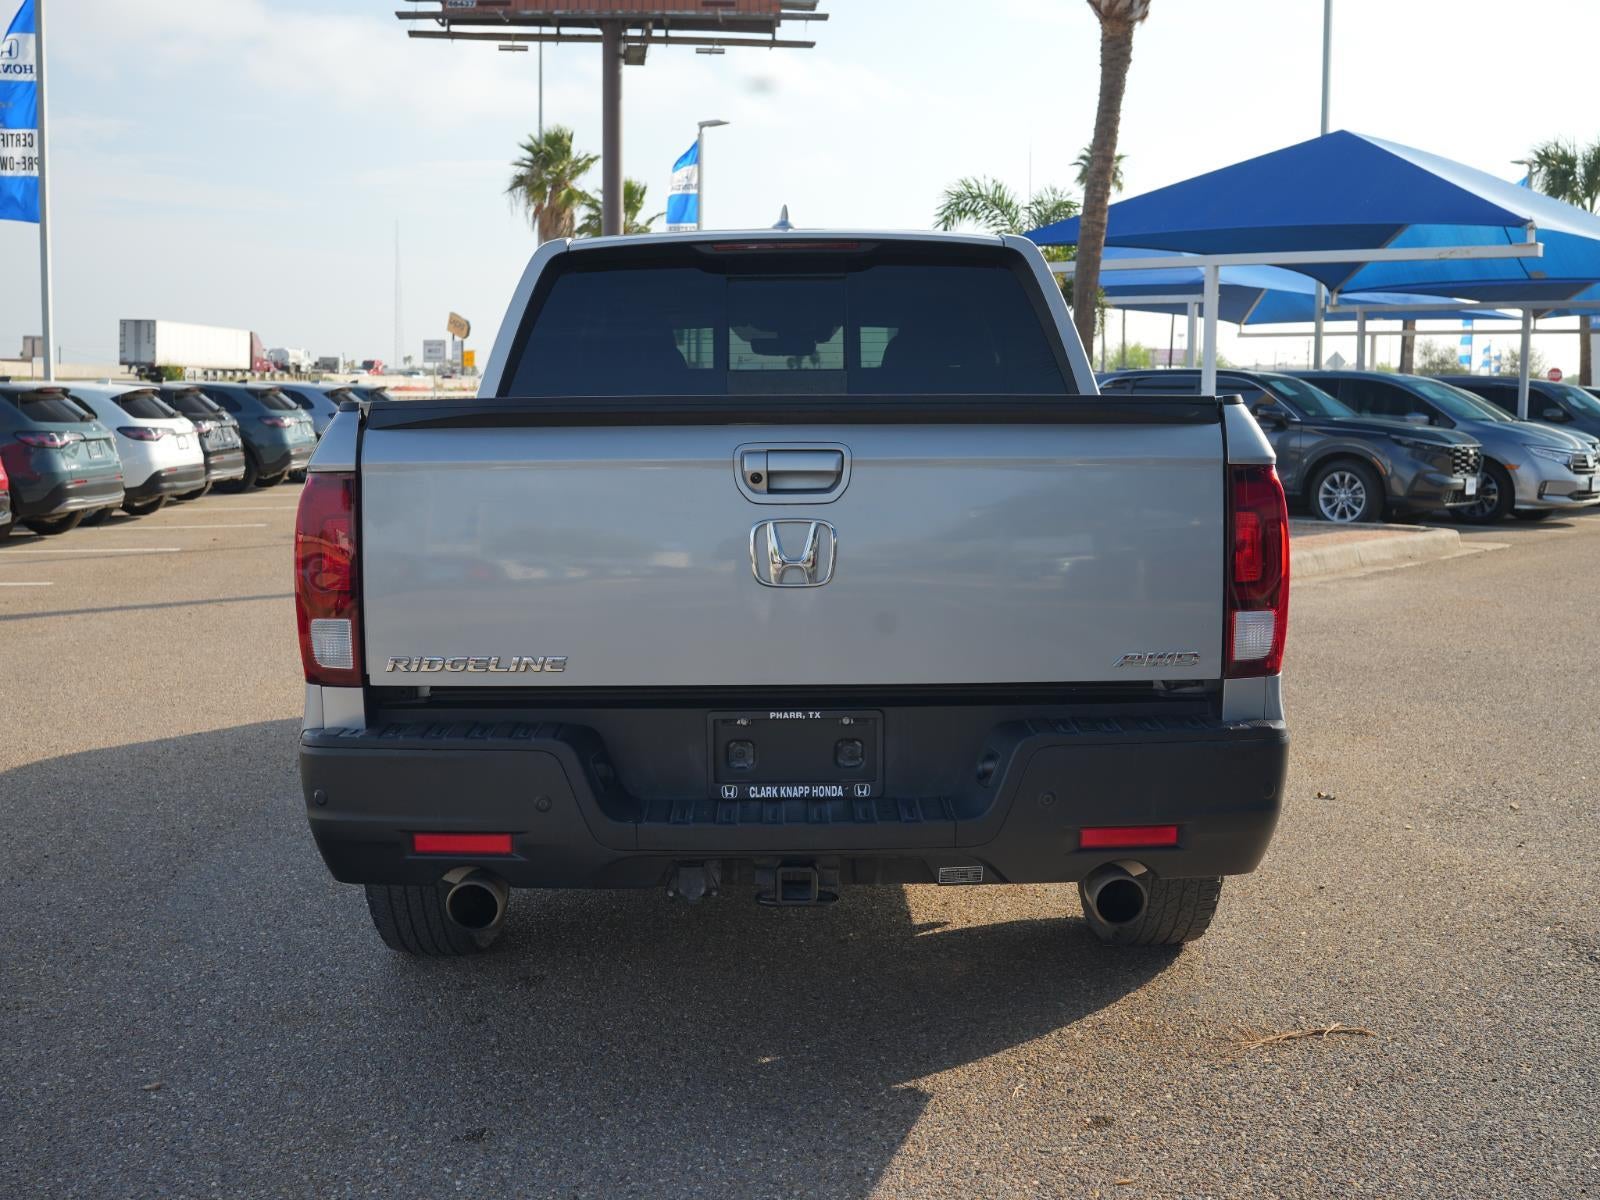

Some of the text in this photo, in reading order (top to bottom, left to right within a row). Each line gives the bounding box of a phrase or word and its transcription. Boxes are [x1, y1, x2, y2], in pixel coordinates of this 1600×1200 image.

[385, 656, 567, 673] RIDGELINE
[769, 711, 821, 719] PHARR, TX
[749, 786, 778, 798] CLARK
[780, 786, 810, 797] KNAPP
[812, 785, 844, 797] HONDA
